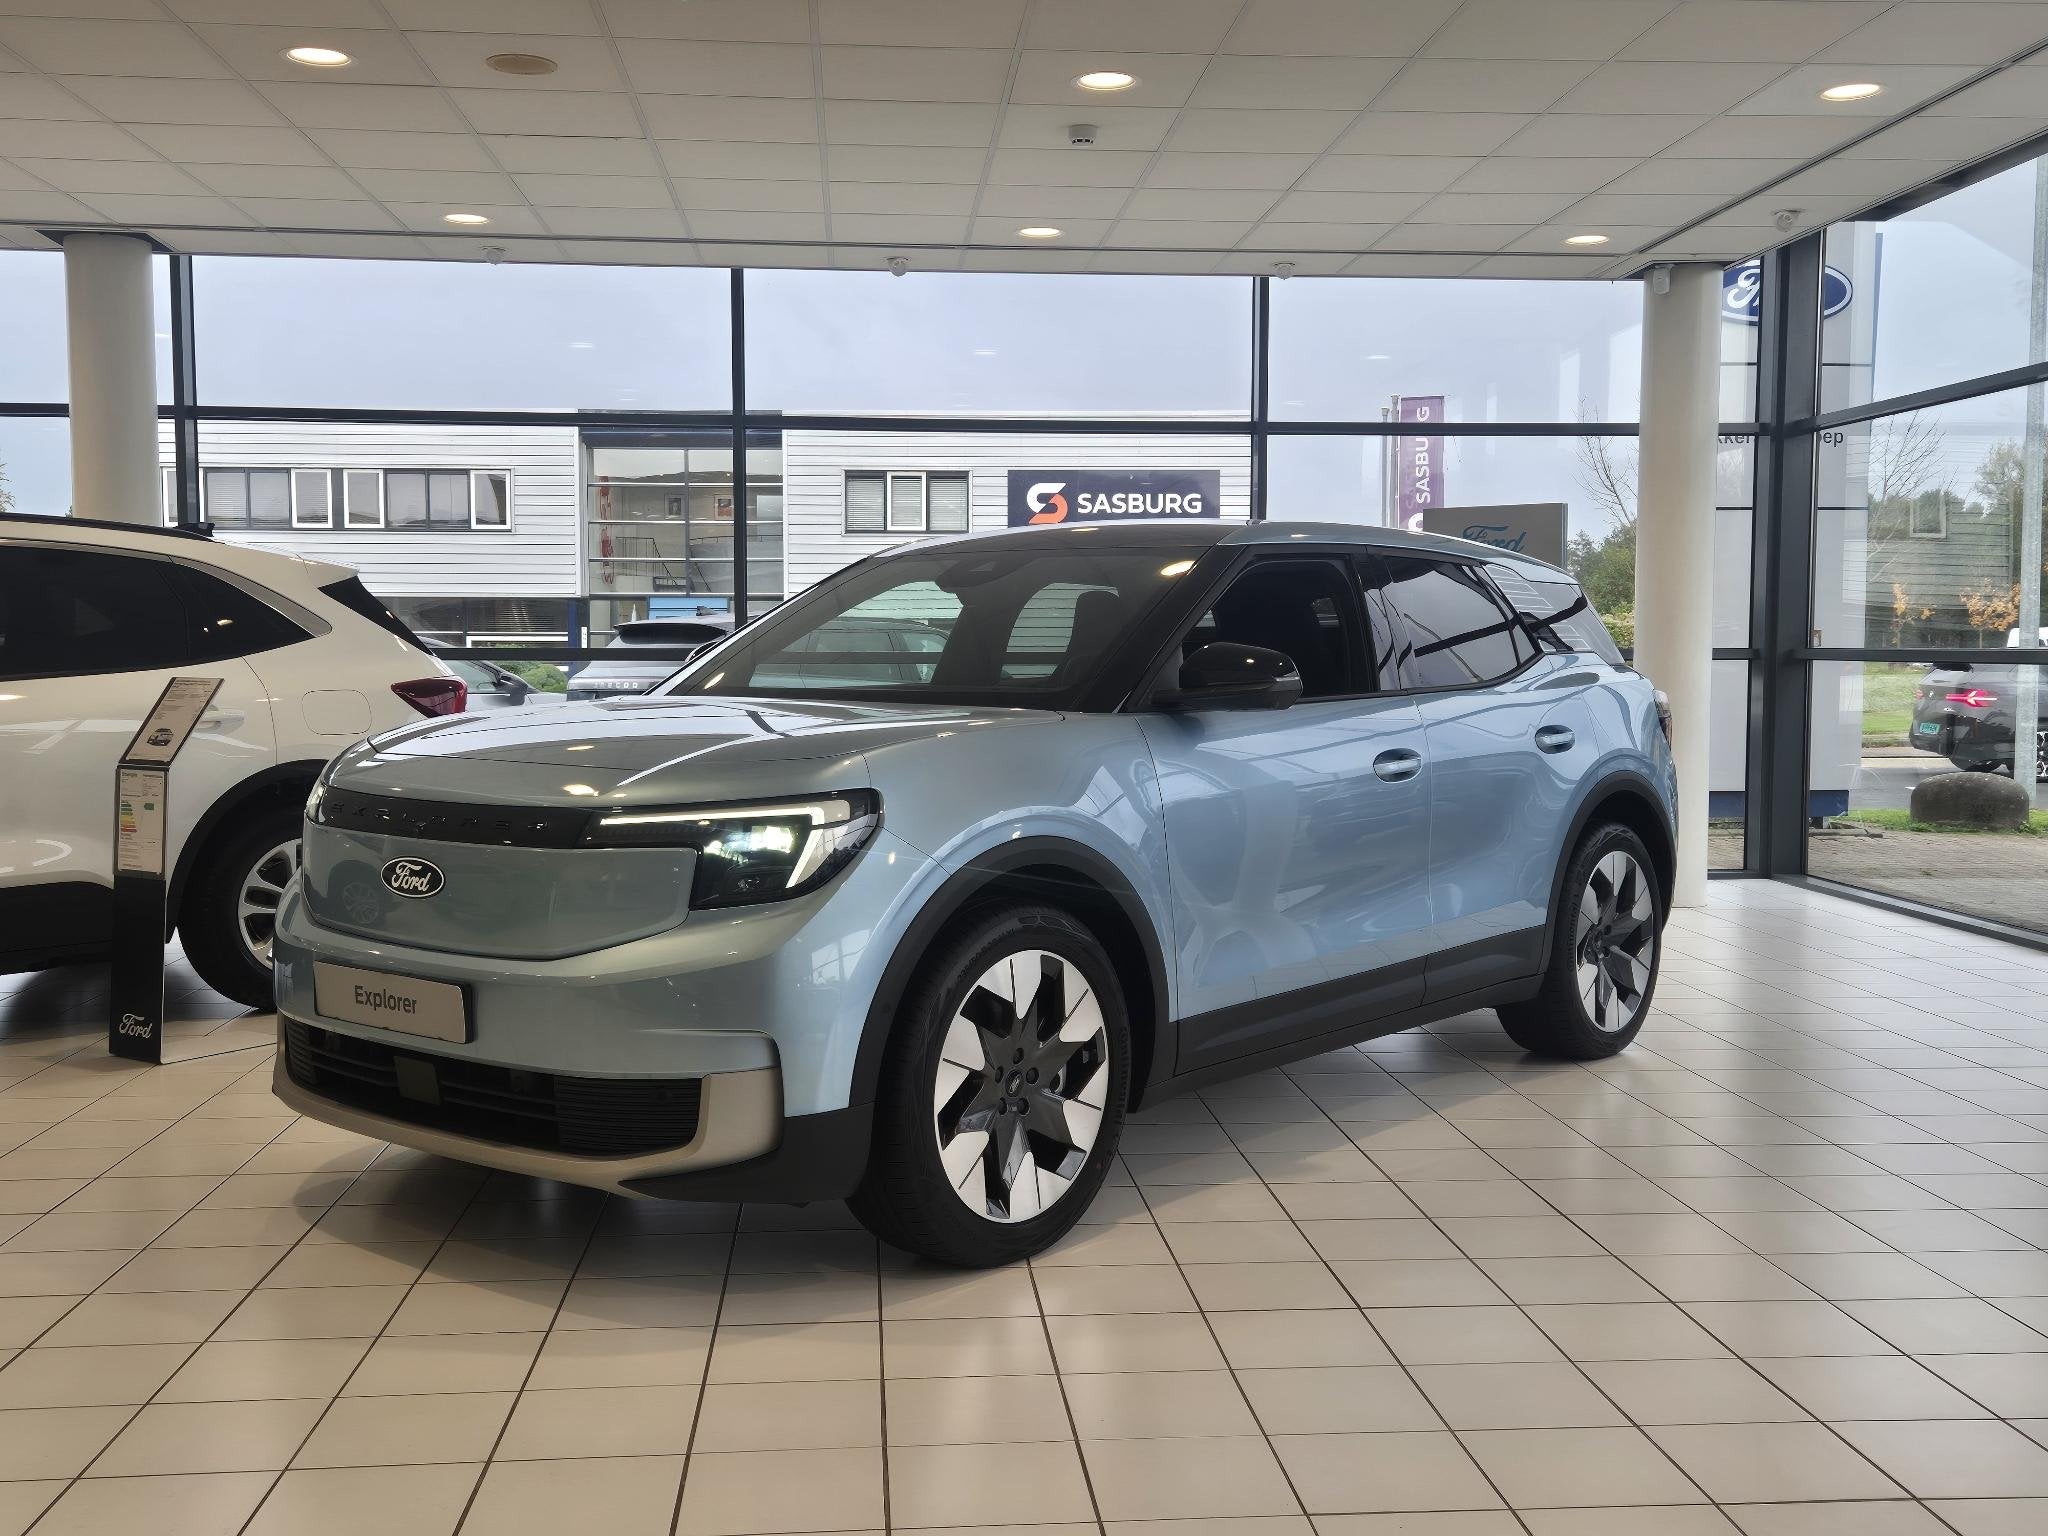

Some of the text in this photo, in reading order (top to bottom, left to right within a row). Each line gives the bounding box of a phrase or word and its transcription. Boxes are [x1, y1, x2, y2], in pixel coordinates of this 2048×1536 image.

[1415, 406, 1431, 503] SASBUG
[1077, 493, 1202, 514] SASBURG
[391, 861, 432, 892] Ford
[354, 985, 417, 1015] Explorer
[119, 1013, 153, 1039] Ford
